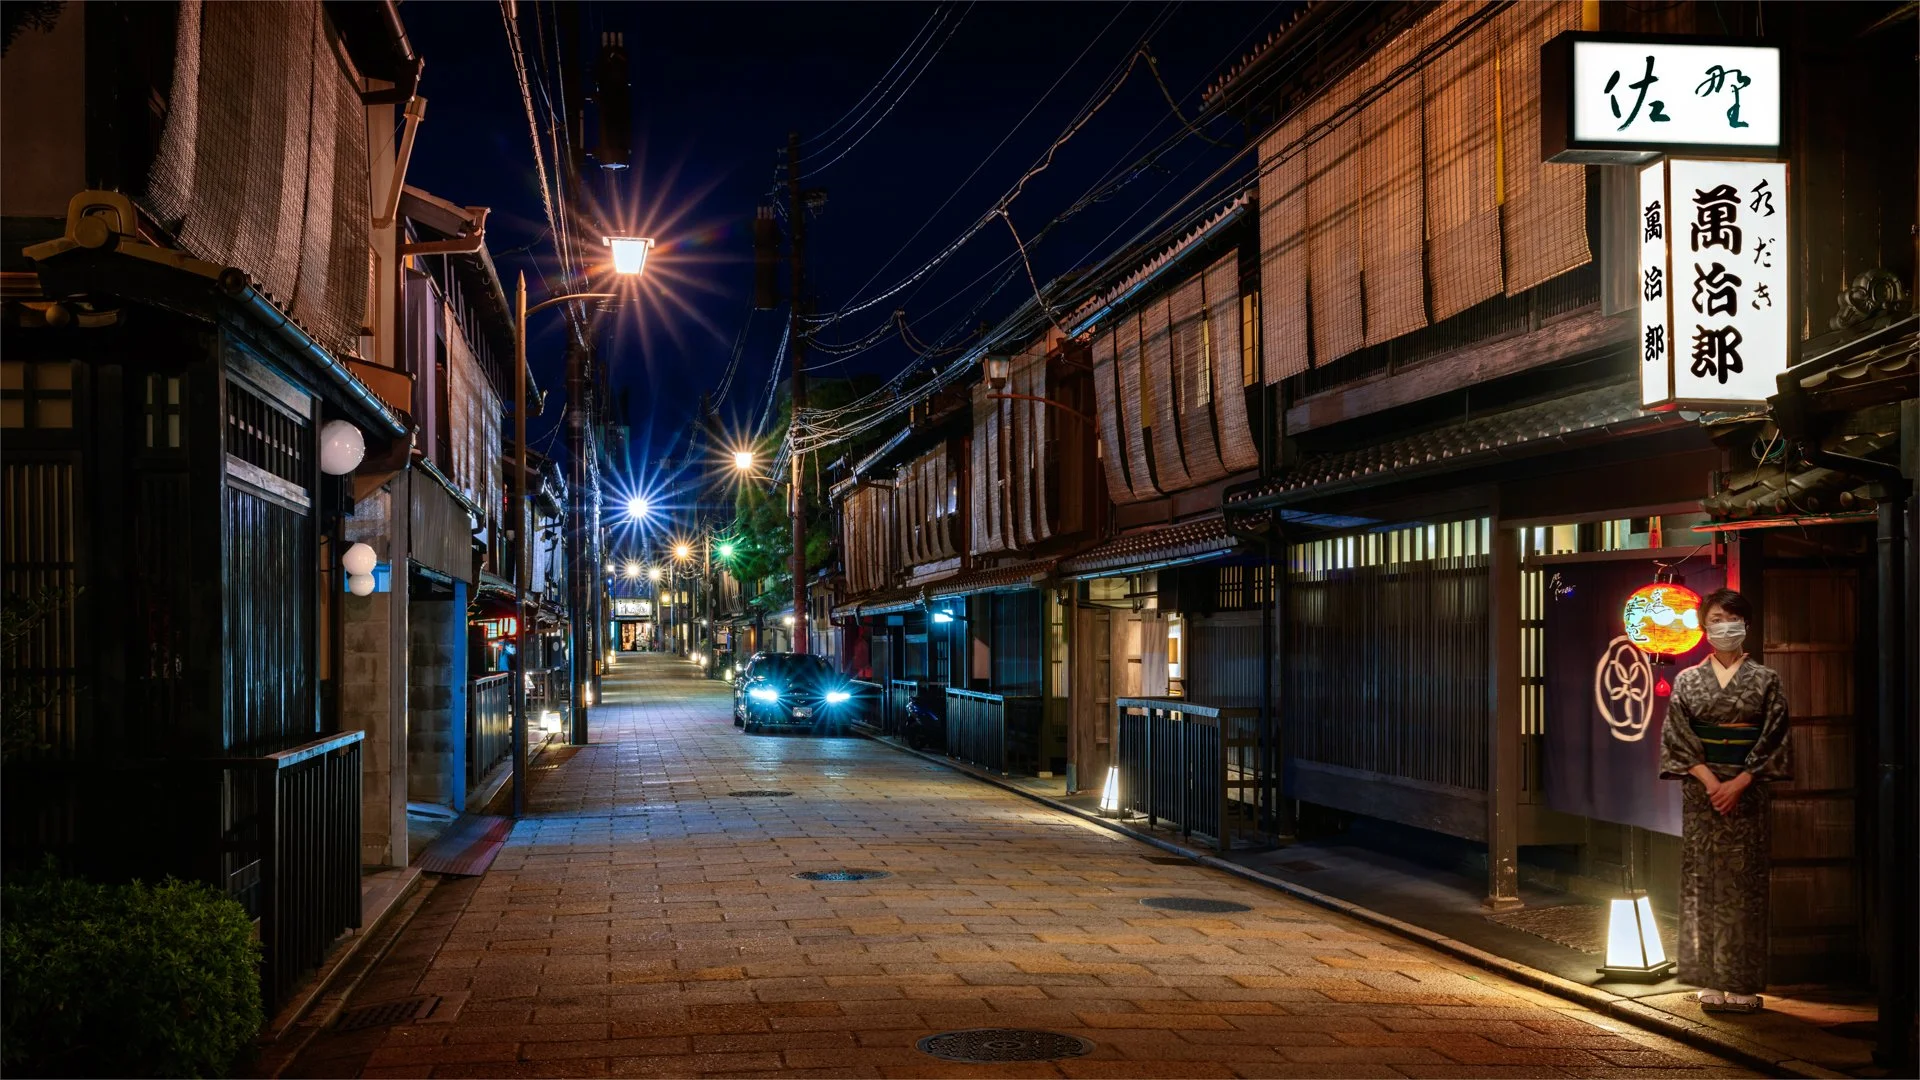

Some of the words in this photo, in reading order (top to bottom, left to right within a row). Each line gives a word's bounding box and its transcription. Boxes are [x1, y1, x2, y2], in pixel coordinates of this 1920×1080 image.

[1644, 200, 1664, 361] 萬治郎
[1691, 184, 1743, 385] 萬治郎
